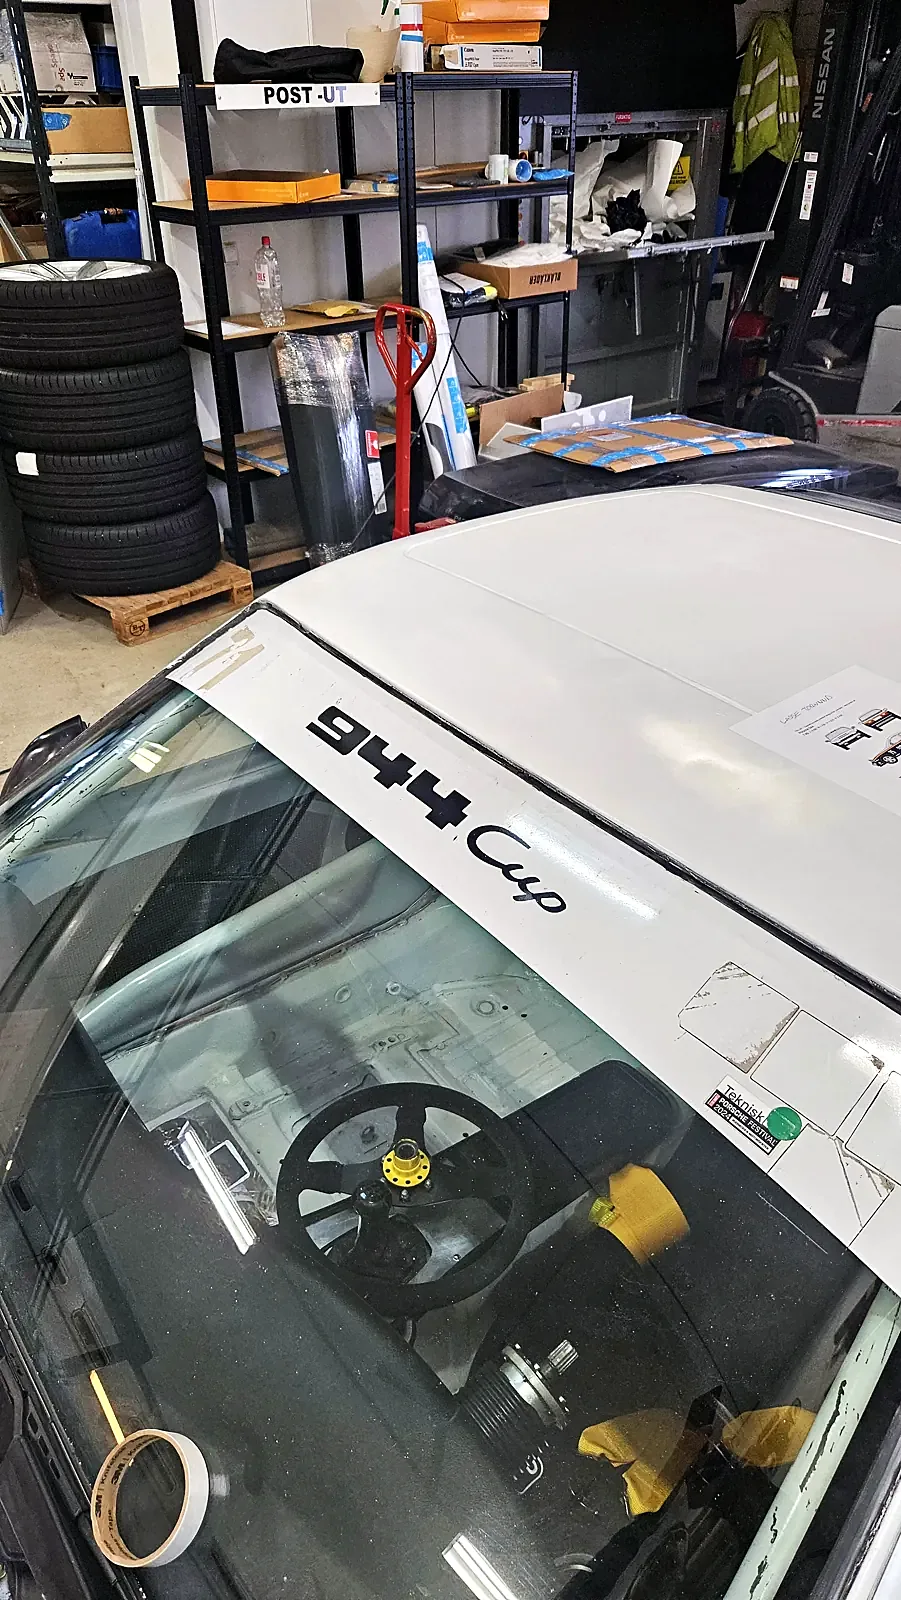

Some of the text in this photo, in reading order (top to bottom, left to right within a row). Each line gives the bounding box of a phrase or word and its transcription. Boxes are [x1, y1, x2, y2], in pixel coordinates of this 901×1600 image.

[812, 28, 836, 119] NISSAN
[263, 86, 313, 104] POST
[305, 705, 472, 830] 944
[466, 824, 567, 913] Cup
[713, 1104, 732, 1120] 2024
[718, 1097, 749, 1123] PORSCHE
[747, 1120, 778, 1147] FESTIVAL
[724, 1084, 765, 1125] Teknisk
[111, 1462, 126, 1485] 3M
[94, 1494, 103, 1518] 3M
